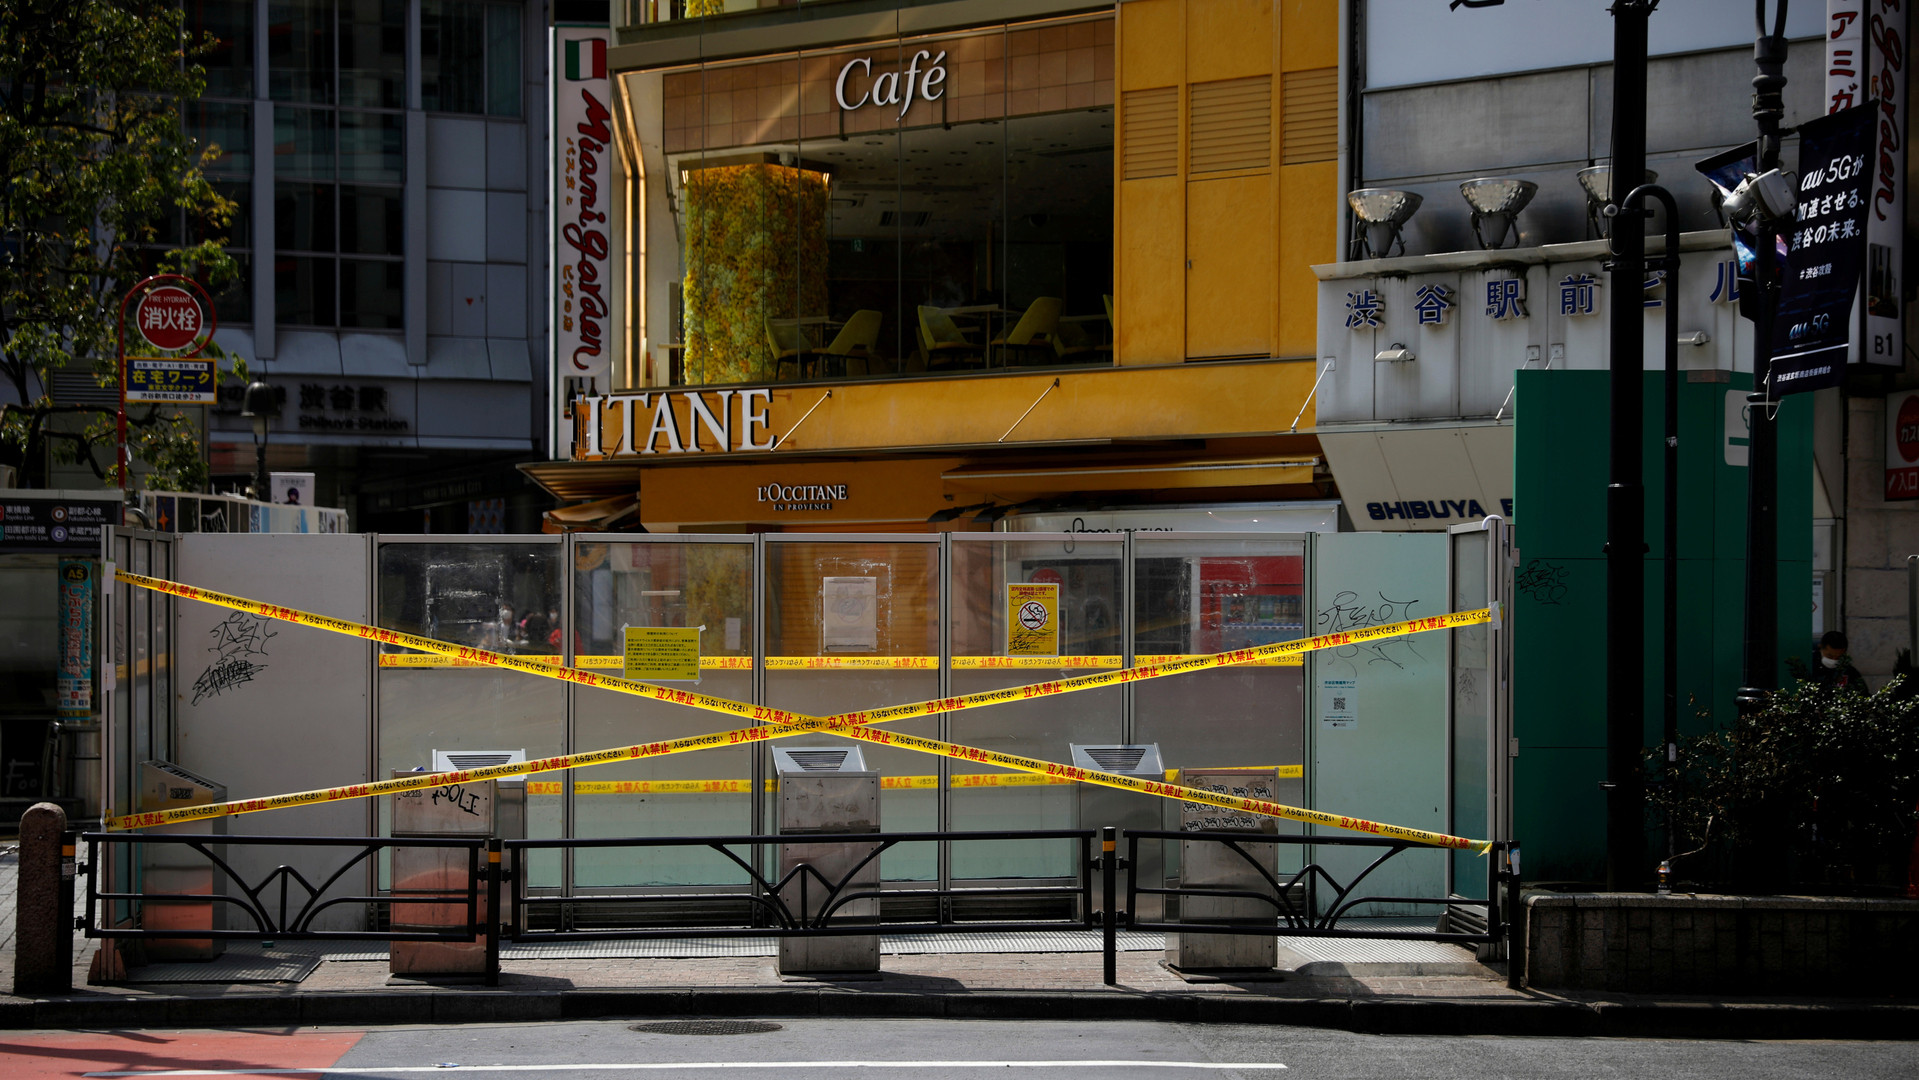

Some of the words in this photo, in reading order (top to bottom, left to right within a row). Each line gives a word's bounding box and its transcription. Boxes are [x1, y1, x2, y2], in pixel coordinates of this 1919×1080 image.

[836, 50, 946, 122] Café
[1800, 168, 1826, 192] au
[1790, 218, 1861, 252] 渋谷の未来。
[149, 295, 162, 303] FIRE
[144, 306, 197, 331] 消火栓
[1788, 320, 1810, 341] au
[1874, 333, 1894, 356] B1
[132, 369, 210, 384] 在宅ワーク
[300, 384, 387, 411] 渋谷駅
[299, 416, 352, 430] Shibuya
[359, 417, 408, 430] Station
[1901, 427, 1919, 443] ガス
[758, 483, 847, 502] L'OCCITANE
[6, 505, 31, 514] 東横線
[68, 506, 101, 516] 副都心線
[1366, 499, 1487, 520] SHIBUYA
[68, 568, 84, 579] A5
[123, 812, 165, 828] 立入禁止
[167, 805, 220, 821] 入らないでください
[226, 800, 268, 814] 立入禁止
[270, 792, 322, 808] 入らないでください
[328, 785, 370, 800] 立入禁止
[373, 778, 424, 794] 入らないでください
[430, 771, 470, 786] 立入禁止
[475, 764, 524, 780] 入らないでください
[530, 757, 571, 772] 立入禁止
[574, 750, 625, 766] 入らないでください
[630, 742, 670, 758] 立入禁止
[673, 735, 723, 751] 入らないでください
[729, 727, 769, 743] 立入禁止
[771, 720, 823, 736] 入らないでください
[828, 712, 868, 729] 立入禁止
[870, 704, 920, 721] 入らないでください
[926, 697, 965, 713] 立入禁止
[968, 689, 1018, 705] 入らないでください
[1023, 682, 1062, 697] 立入禁止
[1066, 673, 1116, 689] 入らないでください
[1120, 666, 1160, 682] 立入禁止
[1162, 657, 1210, 674] 入らないでください
[1216, 649, 1255, 665] 立入禁止
[1258, 641, 1306, 658] 入らないでください
[1312, 632, 1351, 649] 立入禁止
[1354, 625, 1402, 641] 入らないでください
[1408, 616, 1446, 632] 立入禁止
[157, 581, 199, 599] 立入禁止
[202, 590, 254, 610] 入らないでください
[259, 604, 299, 622] 立入禁止
[304, 613, 354, 633] 入らないでください
[359, 626, 399, 644] 立入禁止
[402, 635, 453, 654] 入らないでください
[454, 647, 498, 666] 立入禁止
[502, 656, 552, 675] 入らないでください
[557, 667, 598, 686] 立入禁止
[601, 677, 649, 695] 入らないでください
[656, 688, 695, 705] 立入禁止
[699, 697, 748, 715] 入らないでください
[754, 707, 793, 725] 立入禁止
[850, 726, 891, 744] 立入禁止
[893, 735, 944, 754] 入らないでください
[949, 745, 988, 762] 立入禁止
[991, 754, 1041, 772] 入らないでください
[1046, 764, 1085, 782] 立入禁止
[1089, 772, 1139, 790] 入らないでください
[1144, 782, 1183, 798] 立入禁止
[1186, 790, 1237, 808] 入らないでください
[1242, 800, 1281, 816] 立入禁止
[1284, 808, 1335, 825] 入らないでください
[1340, 817, 1379, 833] 立入禁止
[1382, 825, 1434, 842] 入らないでください
[1438, 834, 1469, 849] 立入禁
